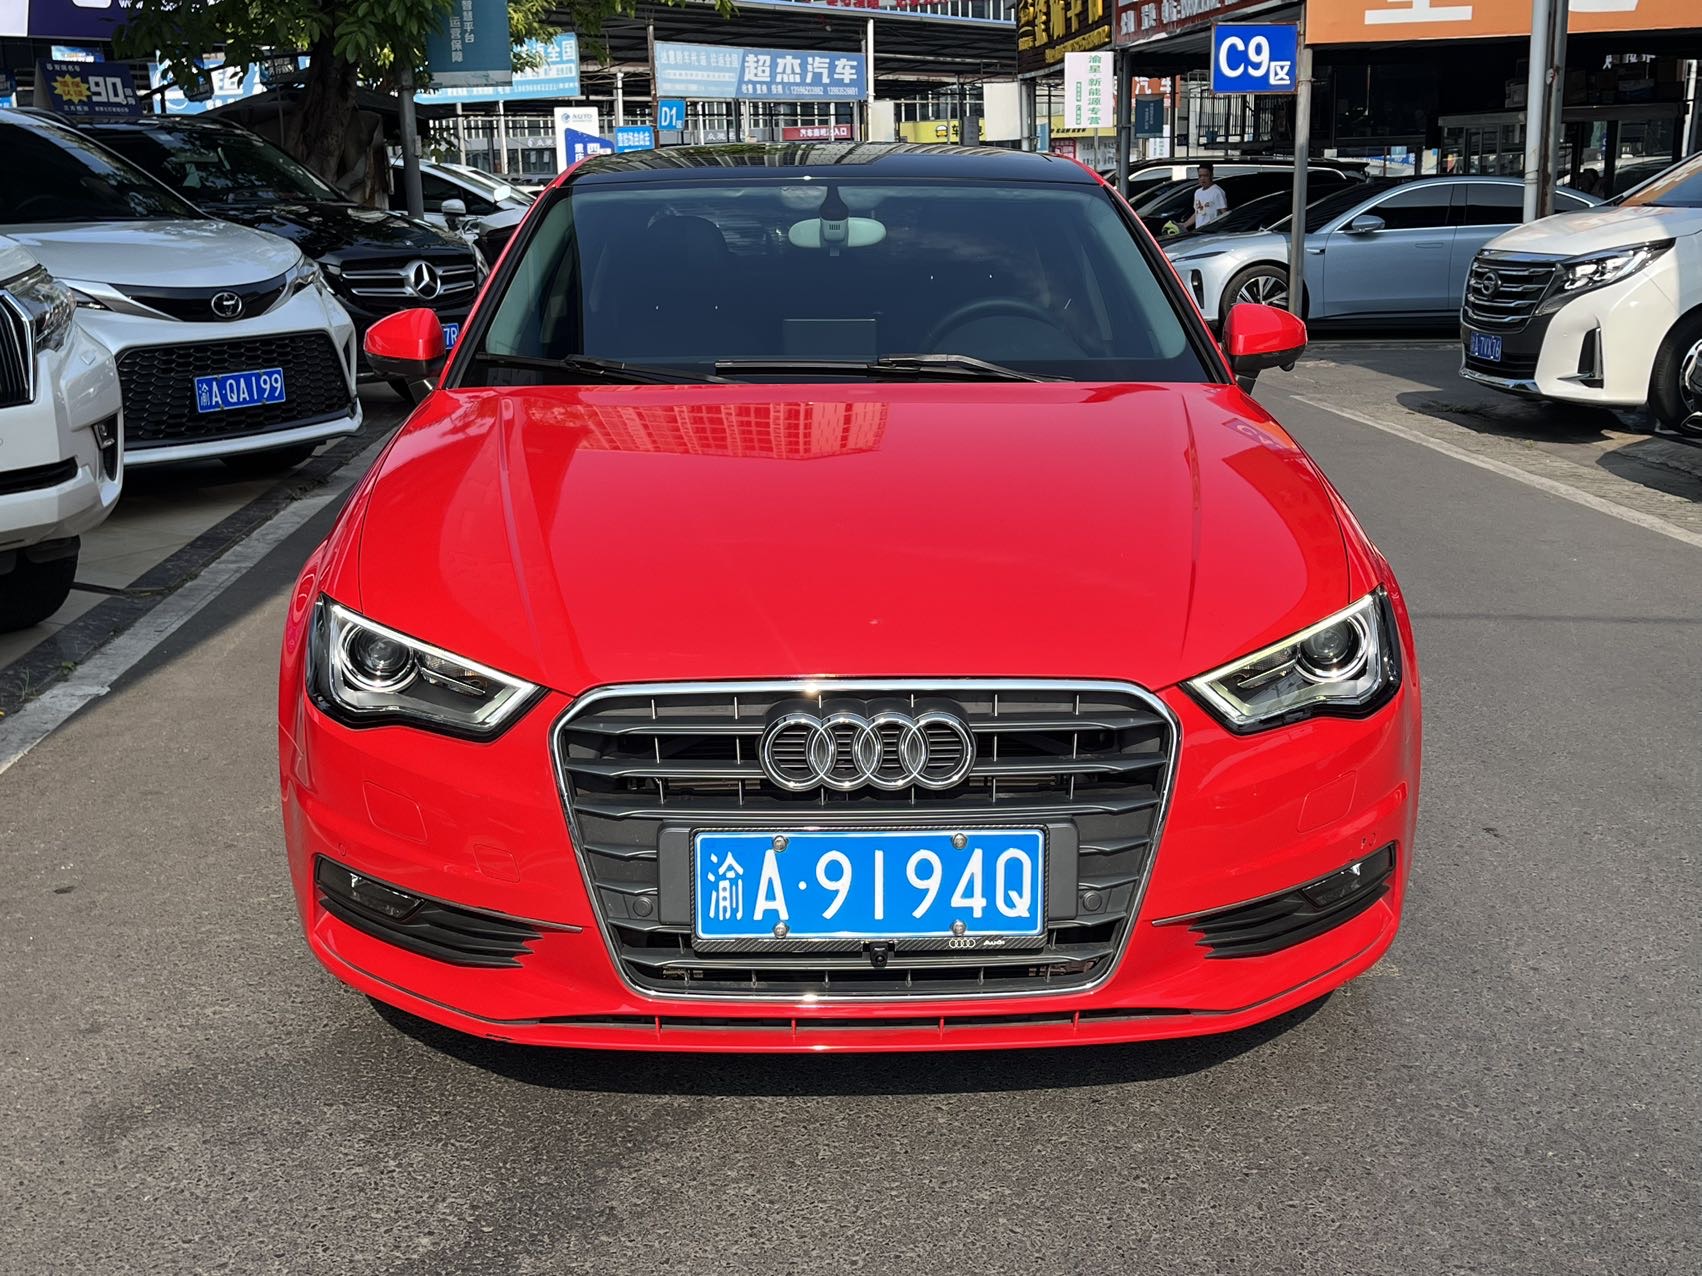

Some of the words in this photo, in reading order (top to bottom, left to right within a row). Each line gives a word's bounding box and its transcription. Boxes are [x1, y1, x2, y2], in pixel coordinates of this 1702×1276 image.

[744, 53, 858, 84] 超杰汽车
[1219, 34, 1291, 85] C9区
[707, 848, 1032, 920] 渝A·9194Q
